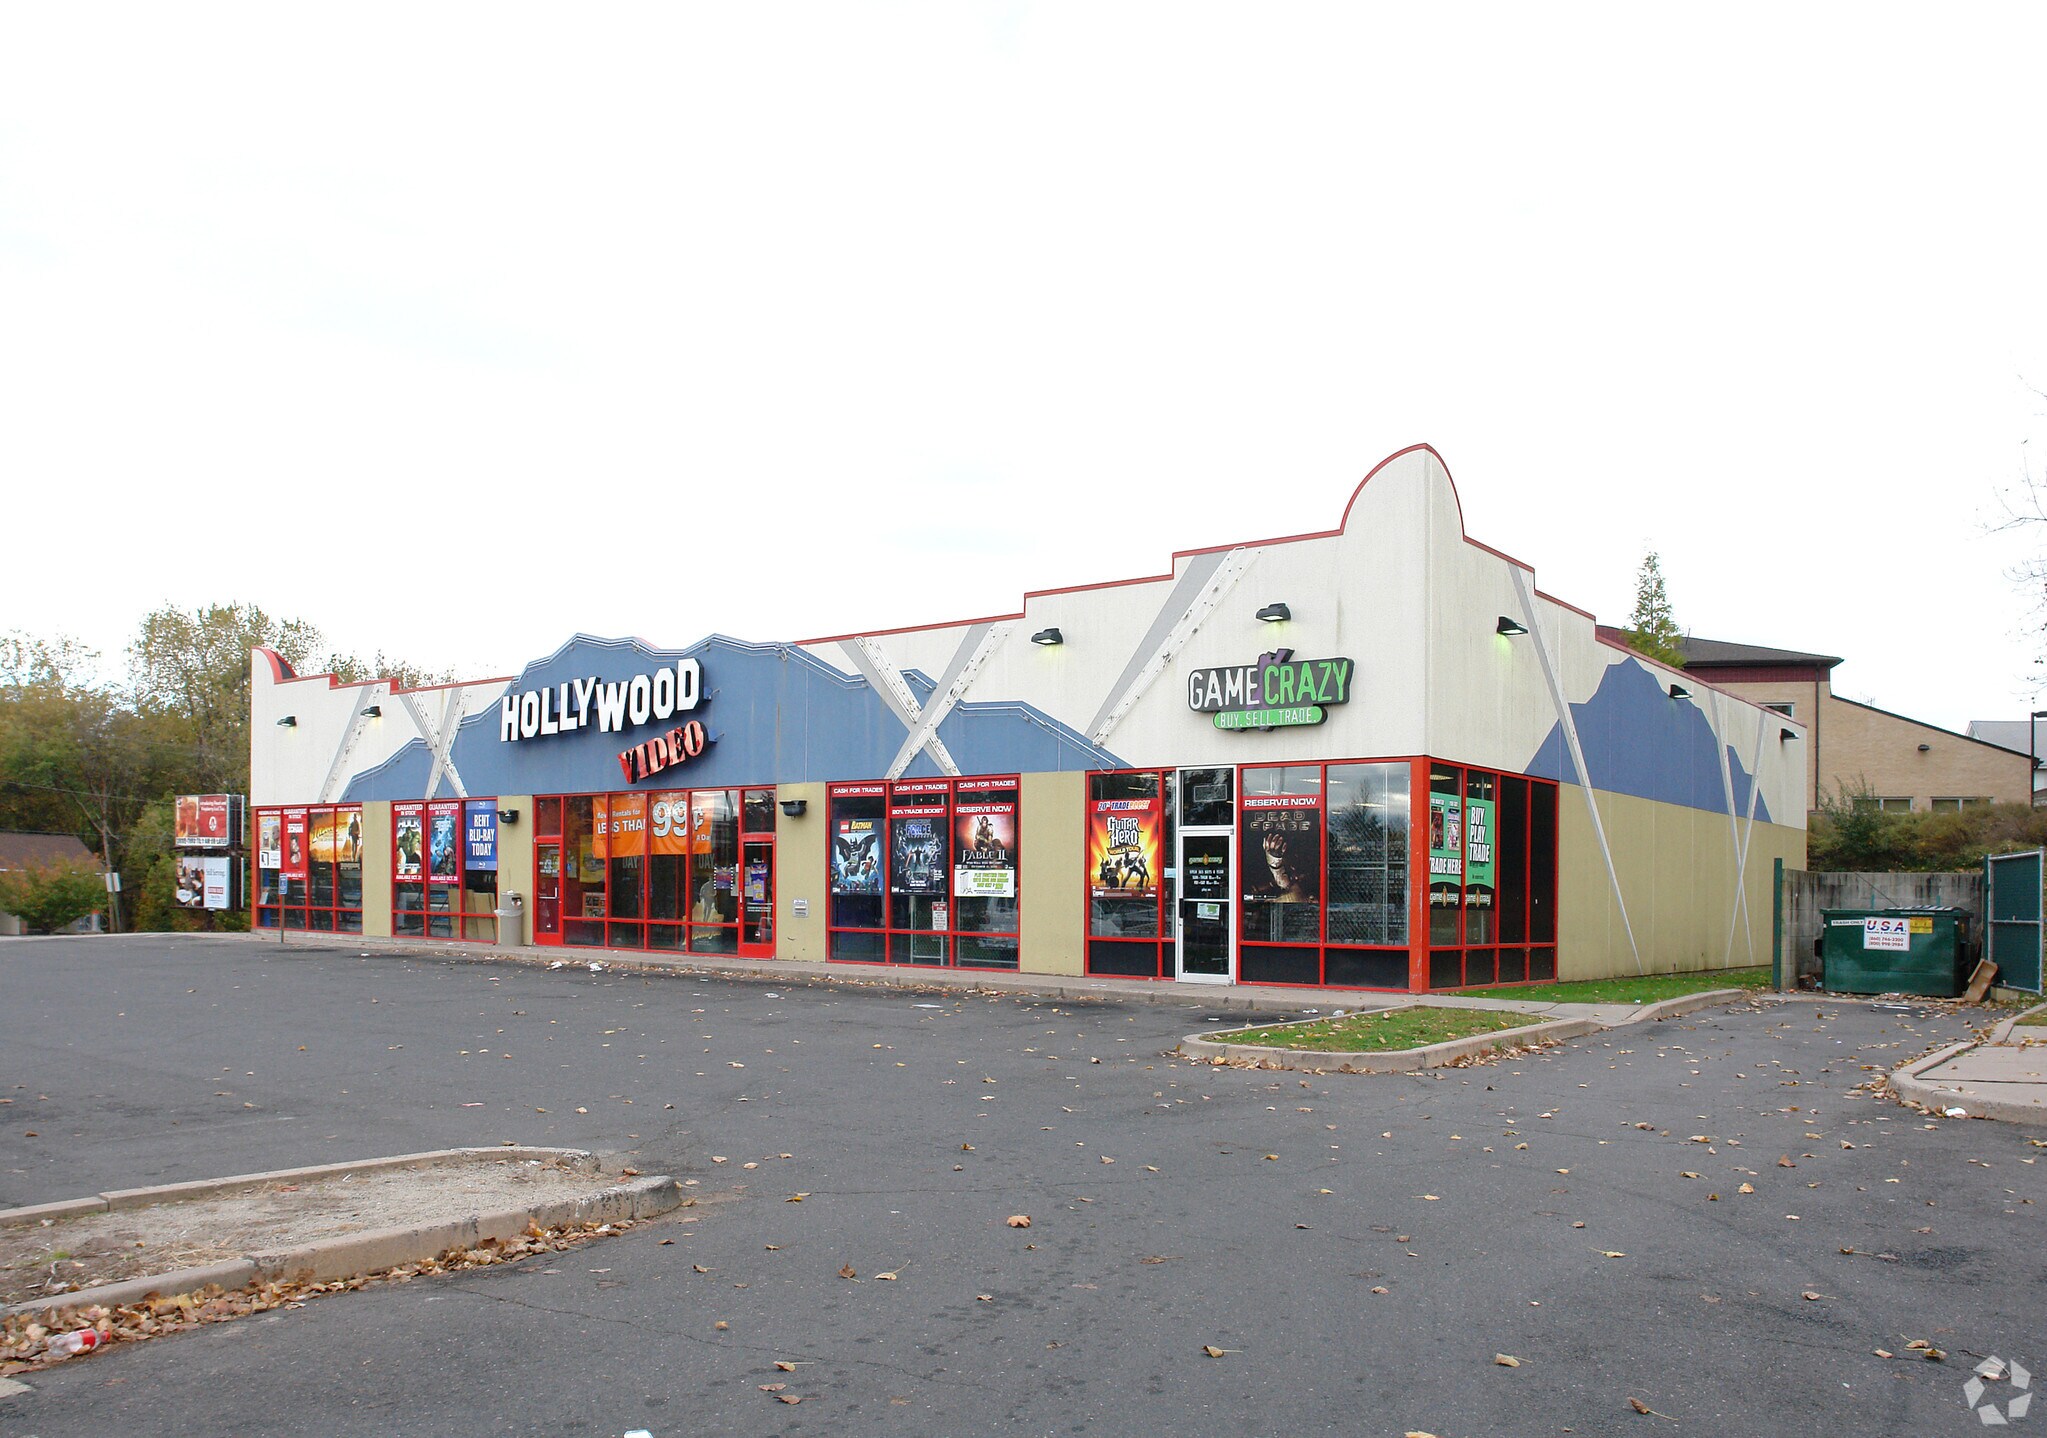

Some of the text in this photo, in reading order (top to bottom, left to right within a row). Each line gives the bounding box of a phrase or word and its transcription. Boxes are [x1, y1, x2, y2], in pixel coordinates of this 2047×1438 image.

[1189, 660, 1348, 710] GAME CRAZY
[500, 657, 704, 743] HOLLYWOOD
[1220, 708, 1317, 728] BUY. SELL. TRADE.
[617, 720, 706, 785] VIDEO
[429, 803, 459, 811] GUARANTEED
[1244, 797, 1317, 806] RESERVE NOW
[956, 805, 1013, 814] RESERVE NOW
[1254, 811, 1306, 822] DEAD
[1470, 806, 1486, 826] BUY
[474, 814, 490, 828] RENT
[851, 820, 873, 830] BATMAN
[468, 828, 495, 842] BLU-RAY
[906, 824, 932, 834] FORCE
[1470, 824, 1486, 844] PLAY
[472, 842, 492, 856] TODAY
[962, 850, 1008, 862] FABLE II
[1469, 843, 1490, 862] TRADE
[1446, 858, 1462, 875] HERE
[1866, 920, 1907, 932] U.S.A.
